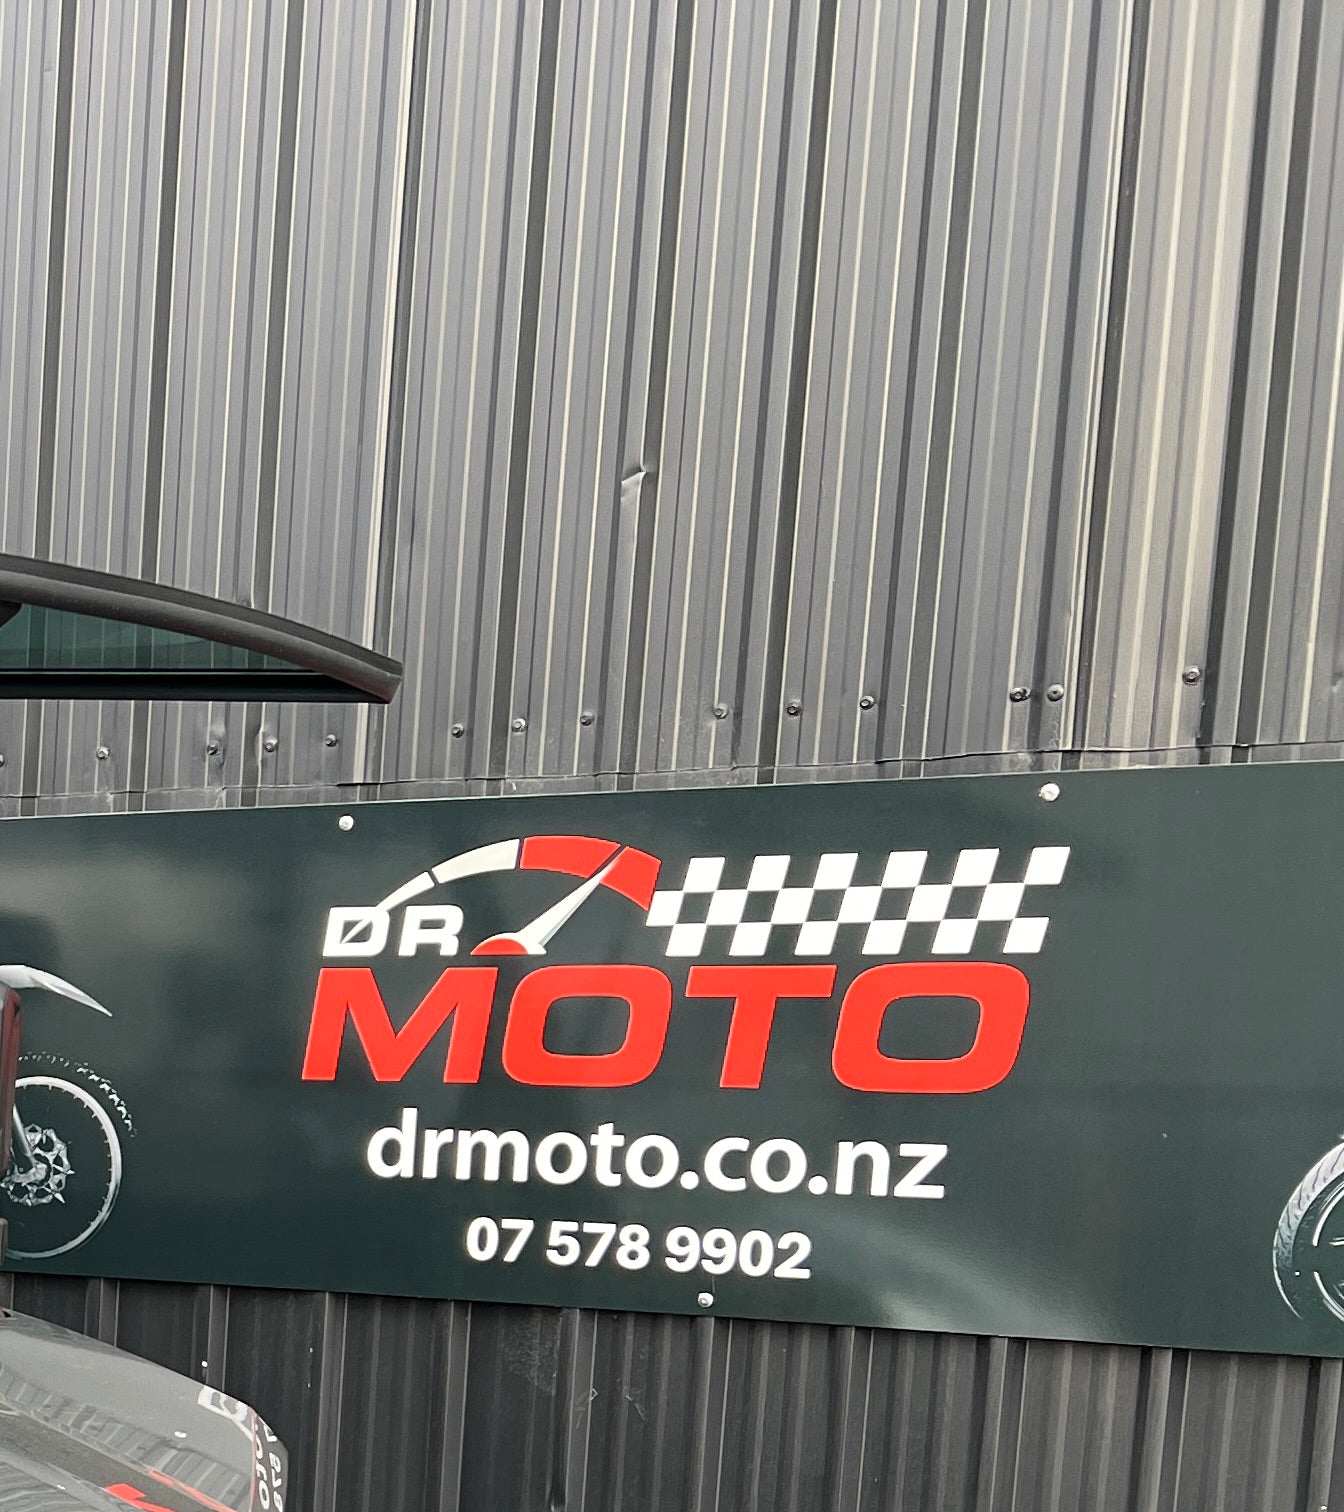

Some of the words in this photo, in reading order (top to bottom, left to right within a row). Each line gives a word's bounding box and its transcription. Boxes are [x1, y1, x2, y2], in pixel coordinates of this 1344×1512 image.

[322, 904, 464, 957] DR
[301, 960, 1031, 1094] MOTO
[367, 1107, 948, 1199] drmoto.co.nz
[465, 1217, 535, 1264] 07
[546, 1220, 651, 1270] 578
[664, 1226, 812, 1280] 9902
